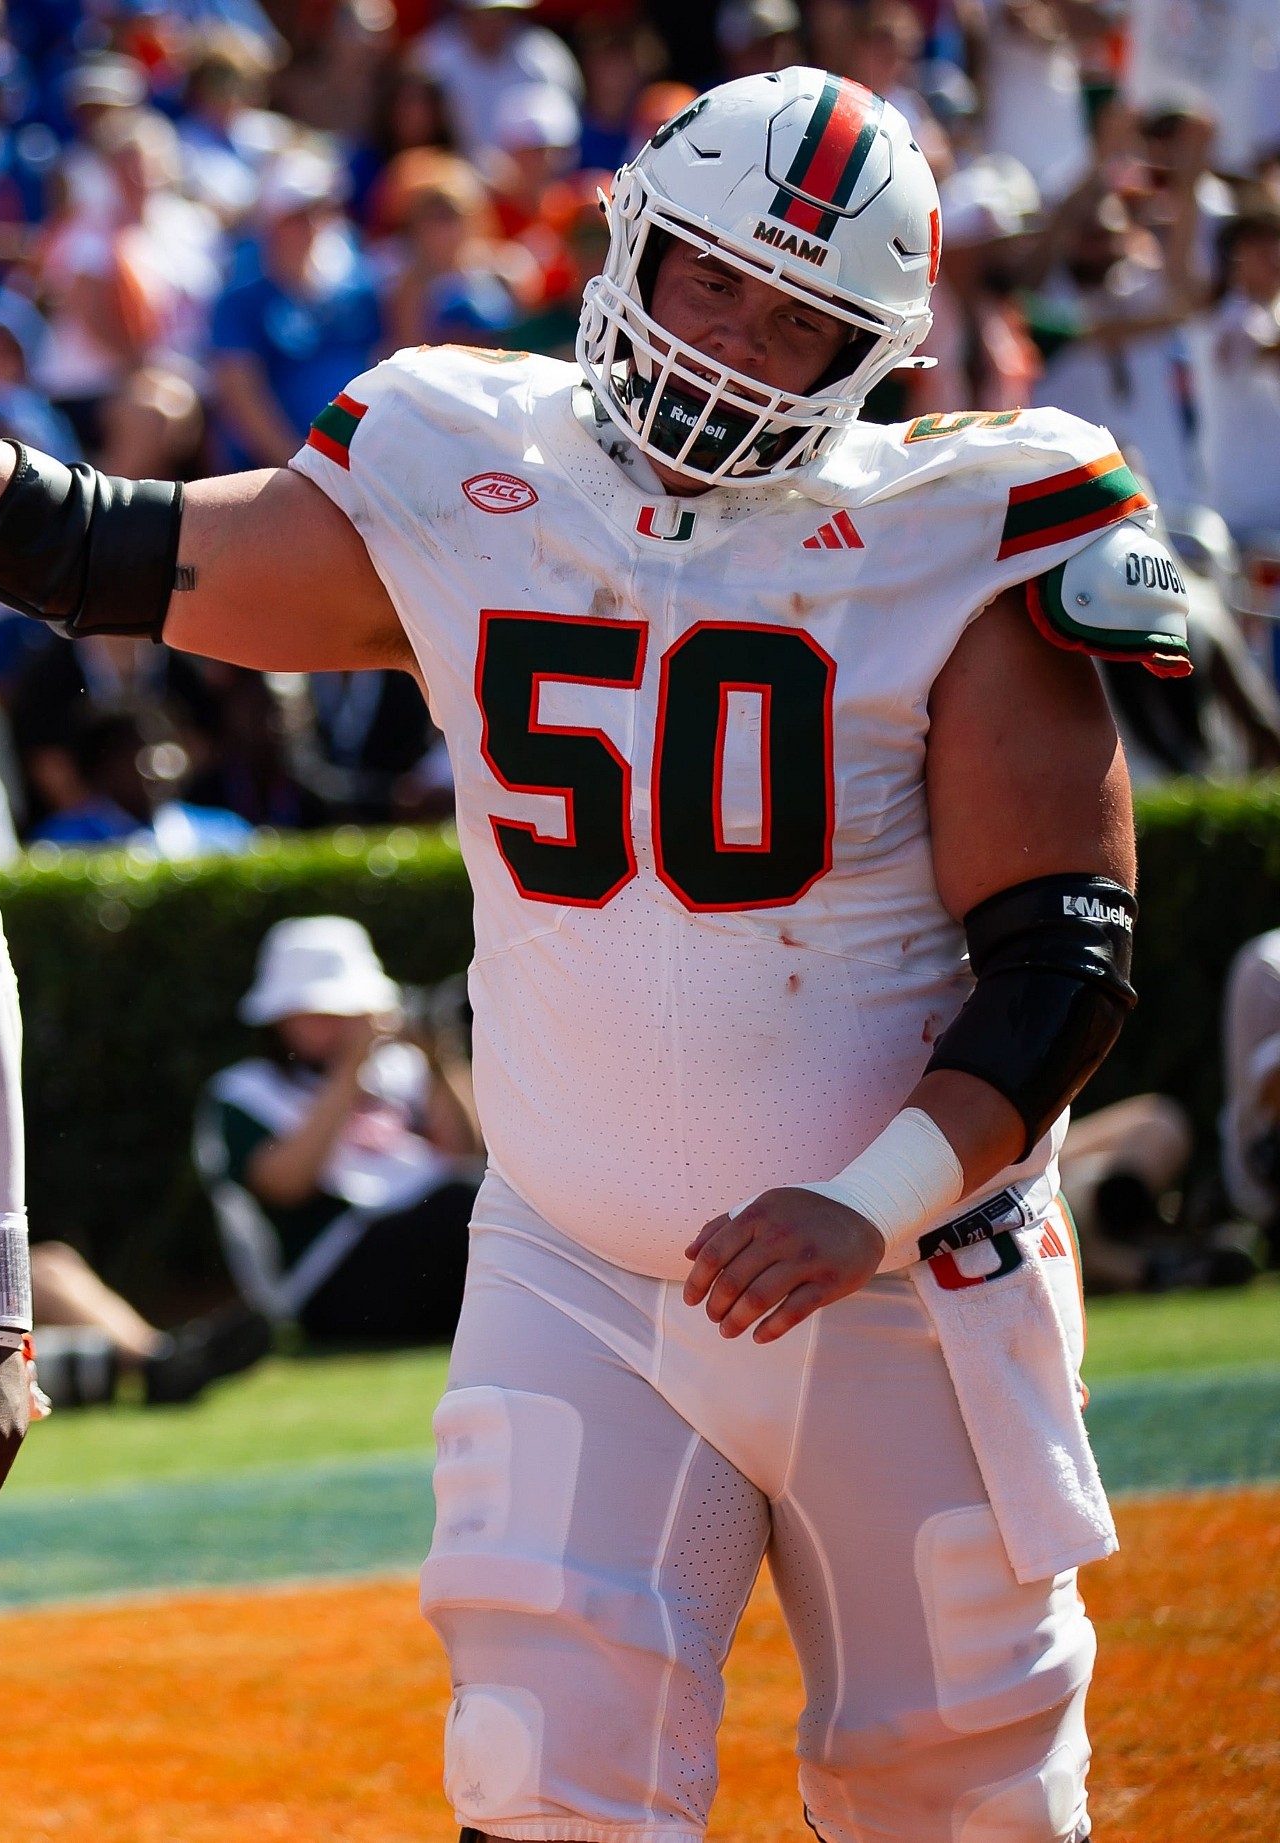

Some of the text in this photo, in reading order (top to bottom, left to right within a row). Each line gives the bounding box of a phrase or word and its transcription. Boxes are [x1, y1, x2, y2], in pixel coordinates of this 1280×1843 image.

[752, 220, 840, 268] MIAMI
[669, 405, 728, 441] Ridell
[475, 482, 528, 500] ACC
[635, 504, 697, 543] U
[473, 608, 838, 914] 50
[927, 1230, 1024, 1291] U
